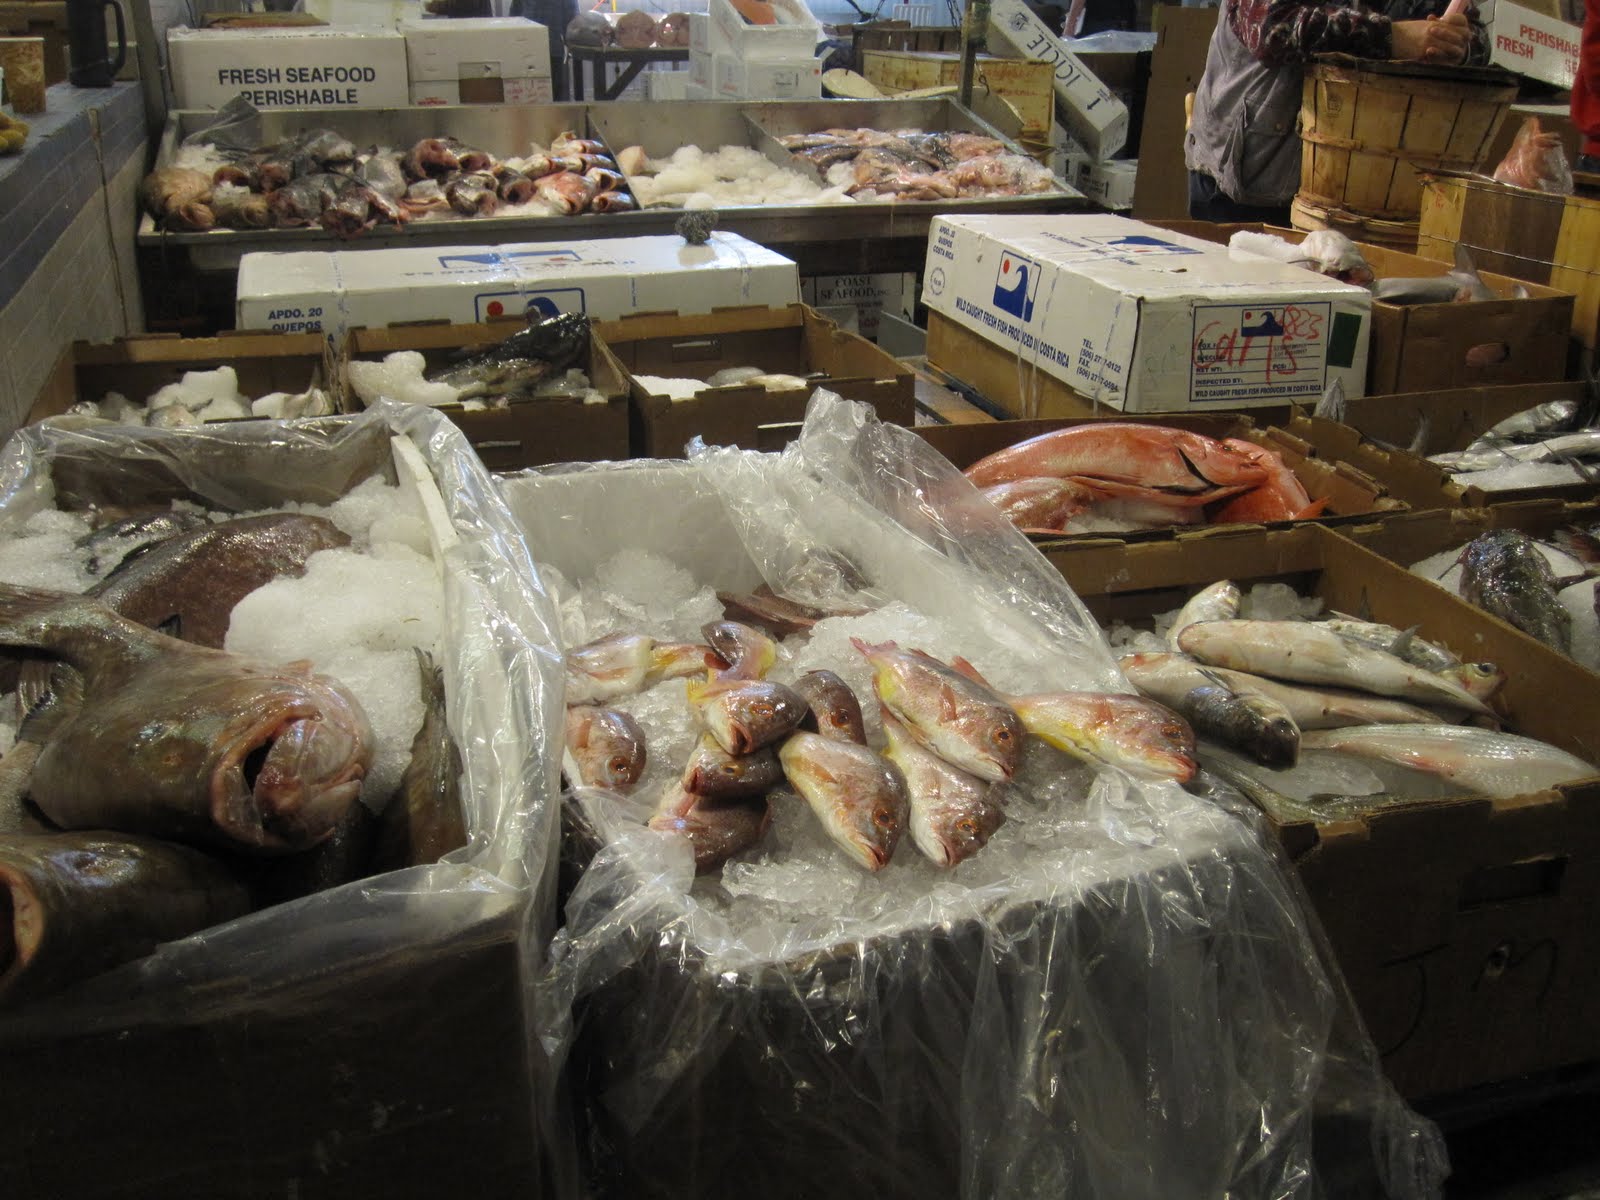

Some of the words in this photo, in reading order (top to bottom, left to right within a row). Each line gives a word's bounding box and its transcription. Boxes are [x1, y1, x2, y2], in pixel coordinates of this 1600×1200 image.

[1496, 35, 1534, 59] FRESH
[1027, 34, 1081, 87] ICICLE
[219, 69, 280, 84] FRESH
[286, 67, 375, 82] SEAFOOD
[241, 89, 358, 105] PERISHABLE
[933, 245, 945, 257] COSTA
[945, 251, 954, 260] RICA
[835, 276, 871, 286] COAST
[268, 309, 304, 320] APDO.
[308, 307, 323, 317] 20
[956, 296, 967, 312] WILD
[966, 303, 983, 321] CAUGHT
[983, 311, 997, 331] FRESH
[996, 319, 1008, 336] FISH
[1040, 341, 1057, 361] COSTA
[1057, 350, 1070, 368] RICA
[1195, 378, 1232, 386] INSPECTED
[1195, 389, 1208, 398] WILD
[1208, 388, 1230, 398] CAUGHT
[1231, 387, 1248, 397] FRESH
[1248, 387, 1260, 396] FISH
[1260, 386, 1286, 395] PRODUCED
[1293, 384, 1309, 393] COSTA
[1309, 384, 1322, 392] RICA
